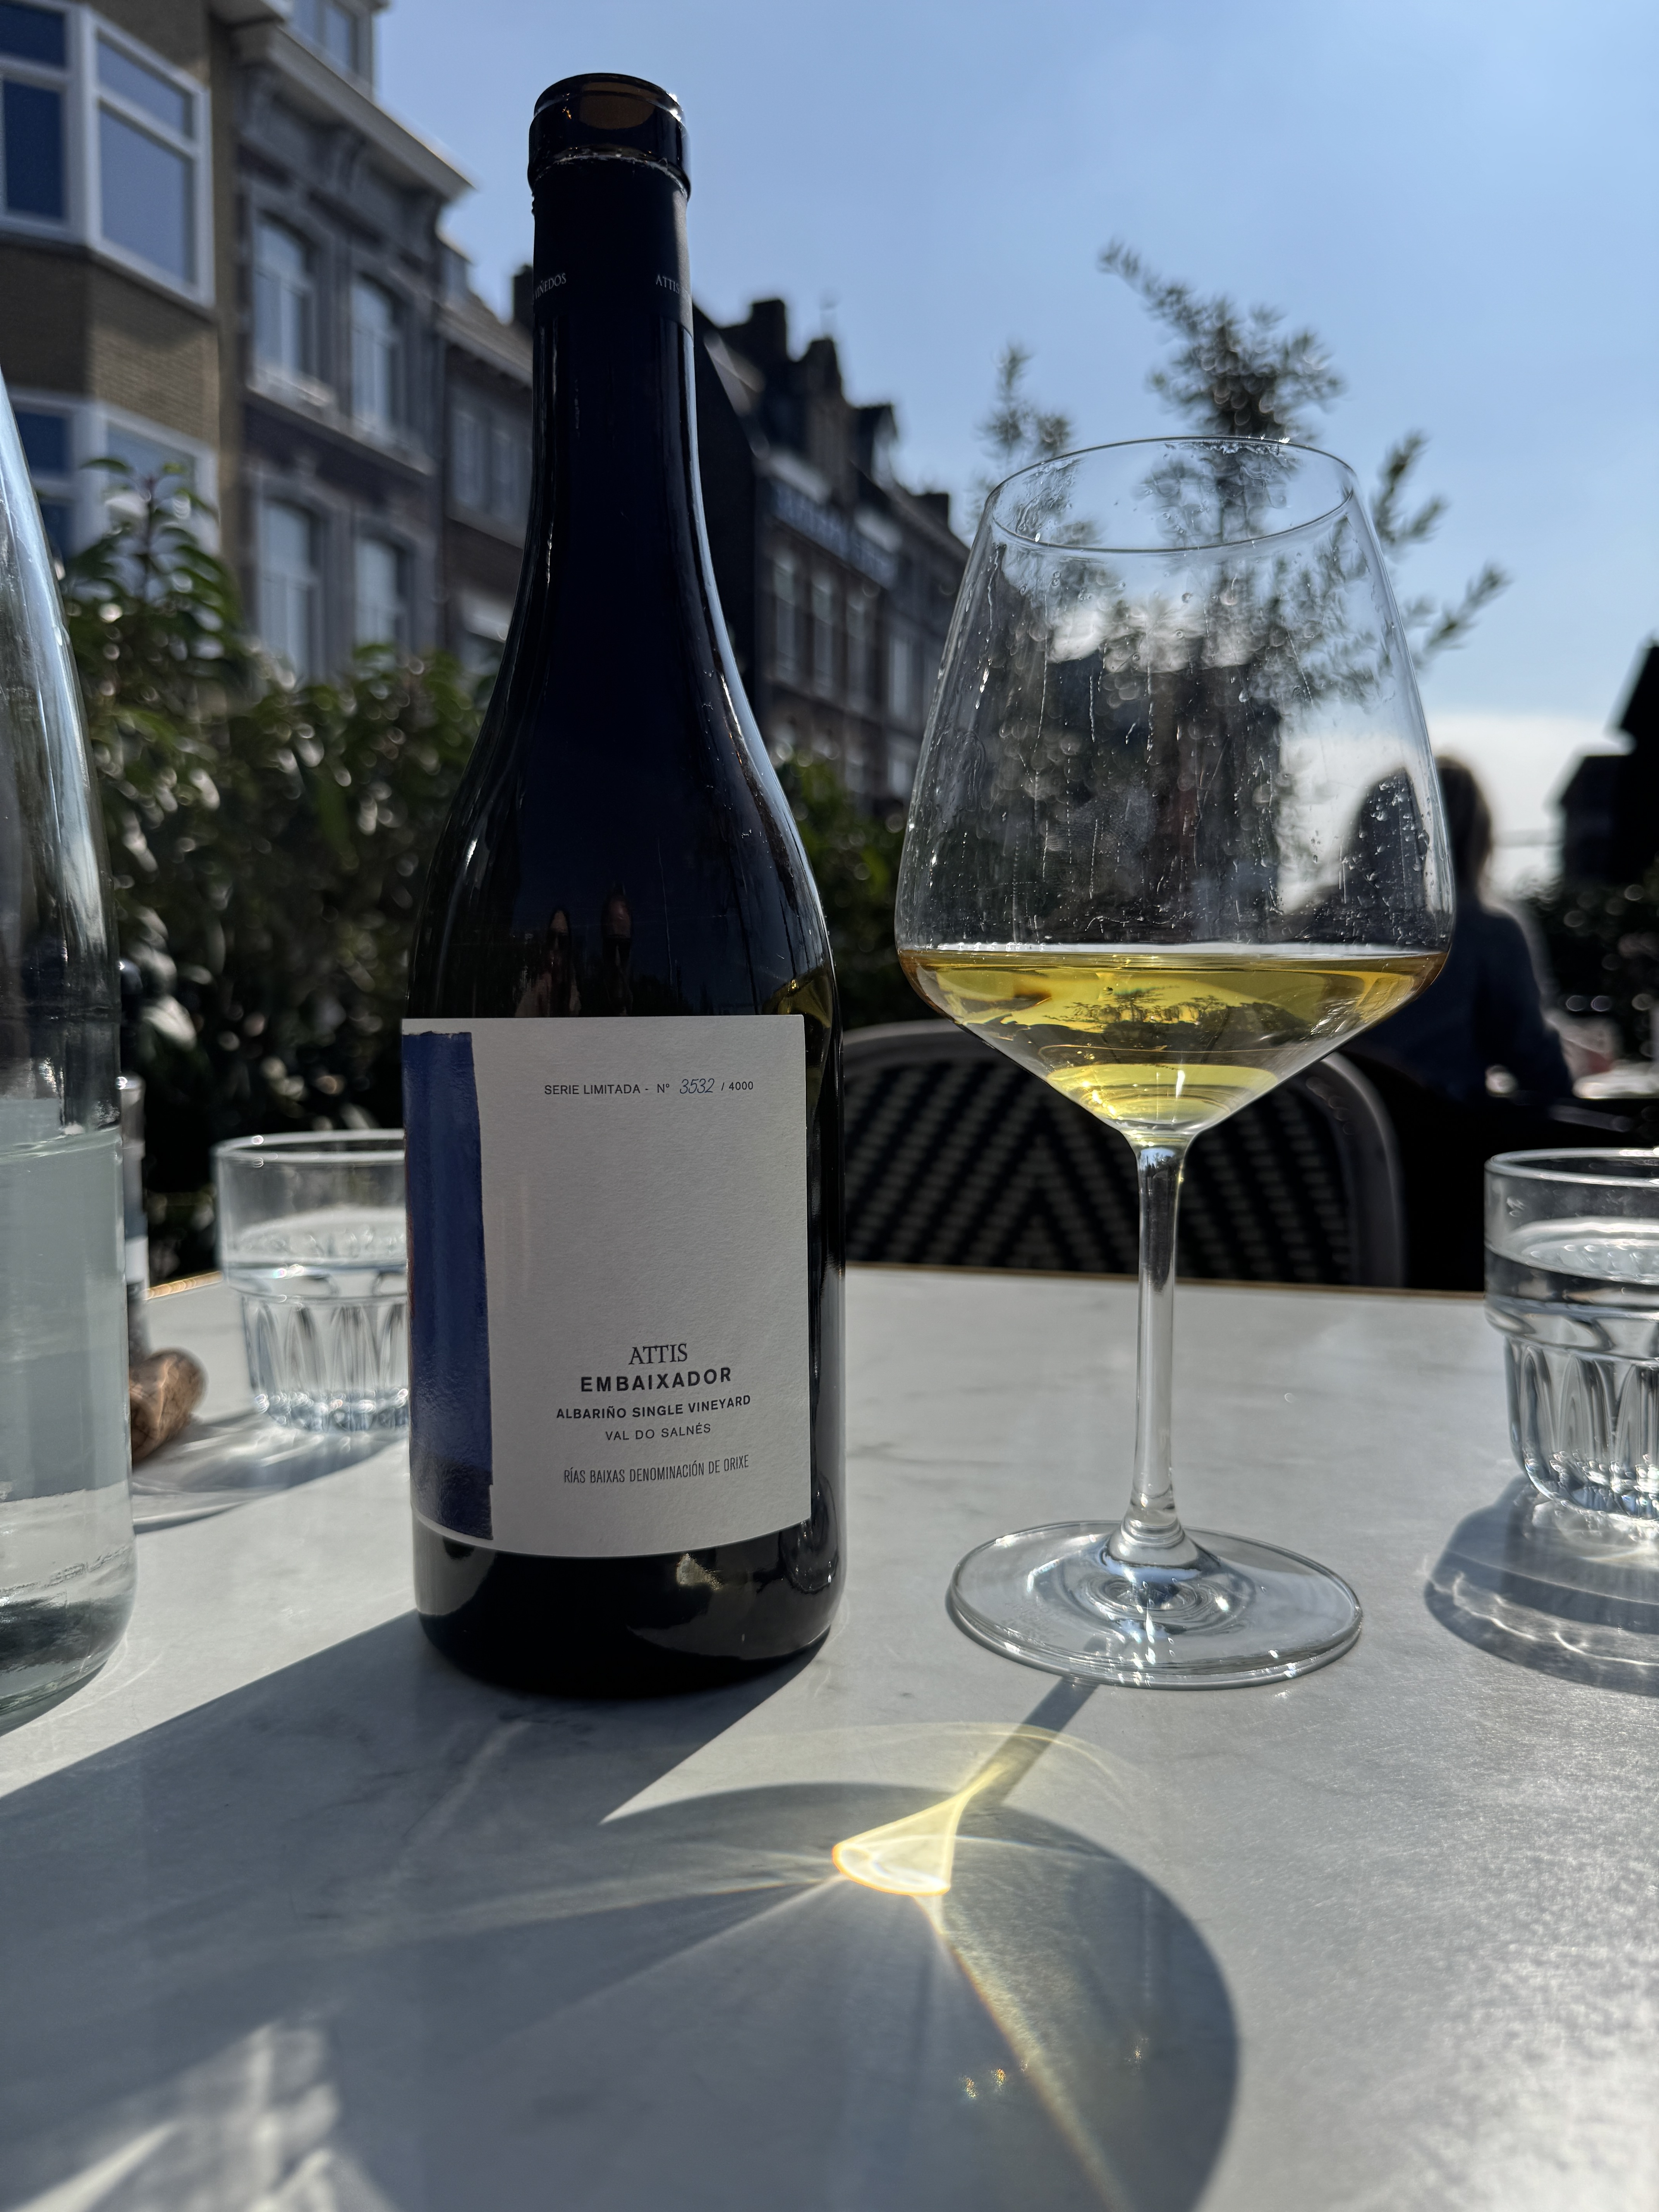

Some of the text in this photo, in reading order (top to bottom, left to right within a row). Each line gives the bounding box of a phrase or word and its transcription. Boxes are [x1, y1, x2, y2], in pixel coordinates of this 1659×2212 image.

[656, 274, 680, 294] ATTIS
[544, 1085, 579, 1095] SERIE
[584, 1084, 641, 1094] LIMITADA
[680, 1078, 715, 1094] 3532
[721, 1082, 725, 1091] /
[728, 1081, 753, 1091] 4000
[628, 1343, 688, 1365] ATTIS
[581, 1367, 731, 1392] EMBAIXADOR
[556, 1395, 750, 1419] ALBARIÑO SINGLE VINEYARD
[605, 1422, 711, 1441] VAL DO SALNÉS
[564, 1454, 749, 1483] RÍAS BAIXAS DENOMINACIÓN DE ORIXE
